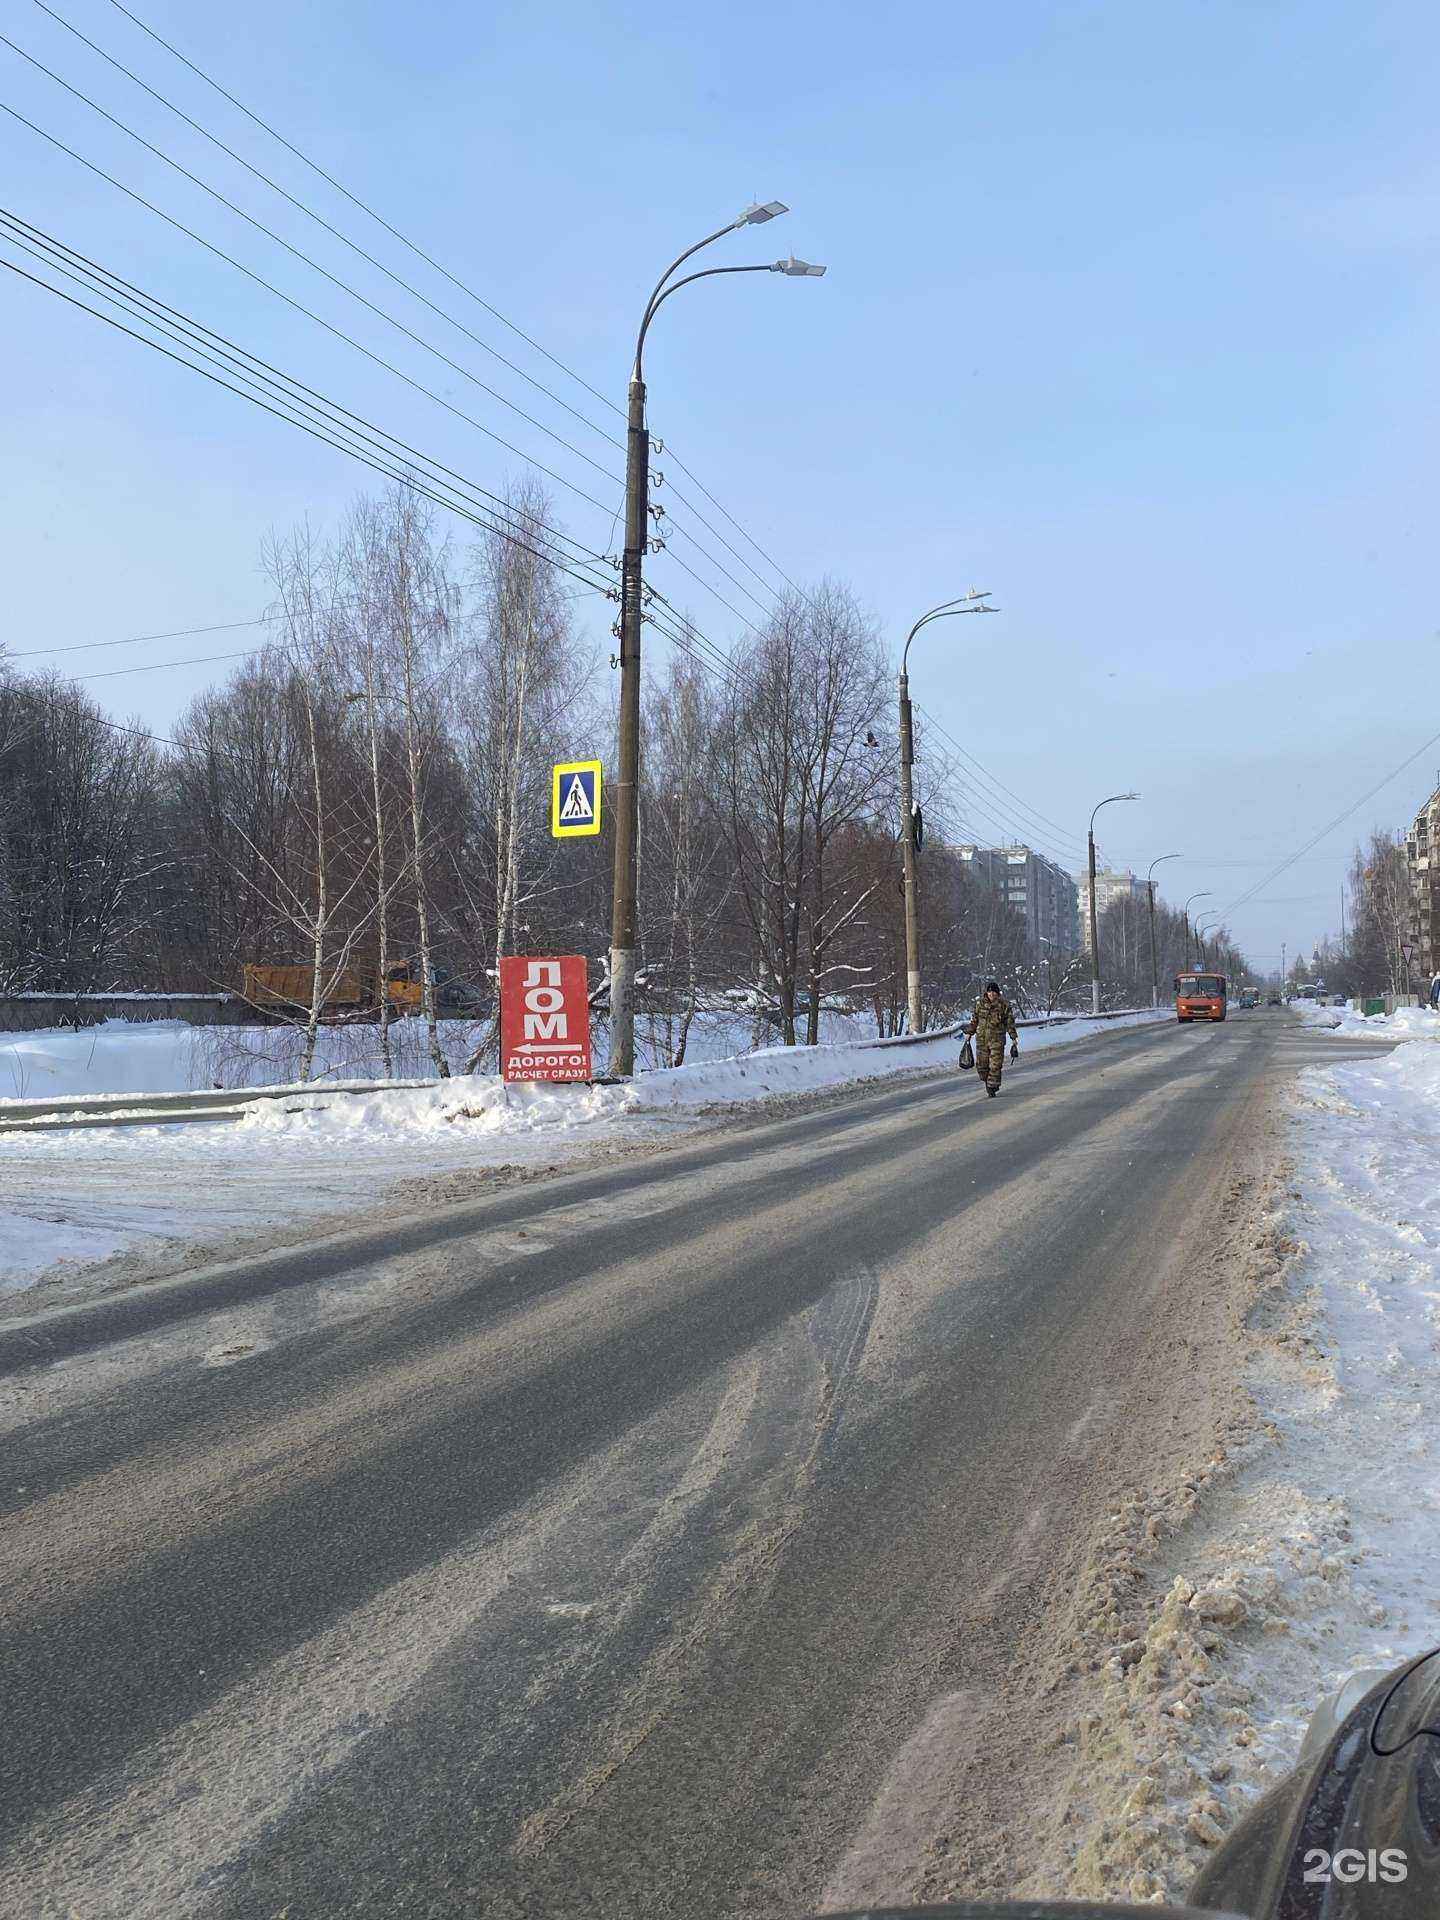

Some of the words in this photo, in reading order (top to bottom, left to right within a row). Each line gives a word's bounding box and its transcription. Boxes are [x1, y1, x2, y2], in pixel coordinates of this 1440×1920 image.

[522, 961, 567, 1039] ЛОМ
[508, 1055, 587, 1069] ДОРОГО!
[508, 1070, 549, 1079] РАСЧЕТ
[551, 1069, 587, 1078] СРАЗУ!
